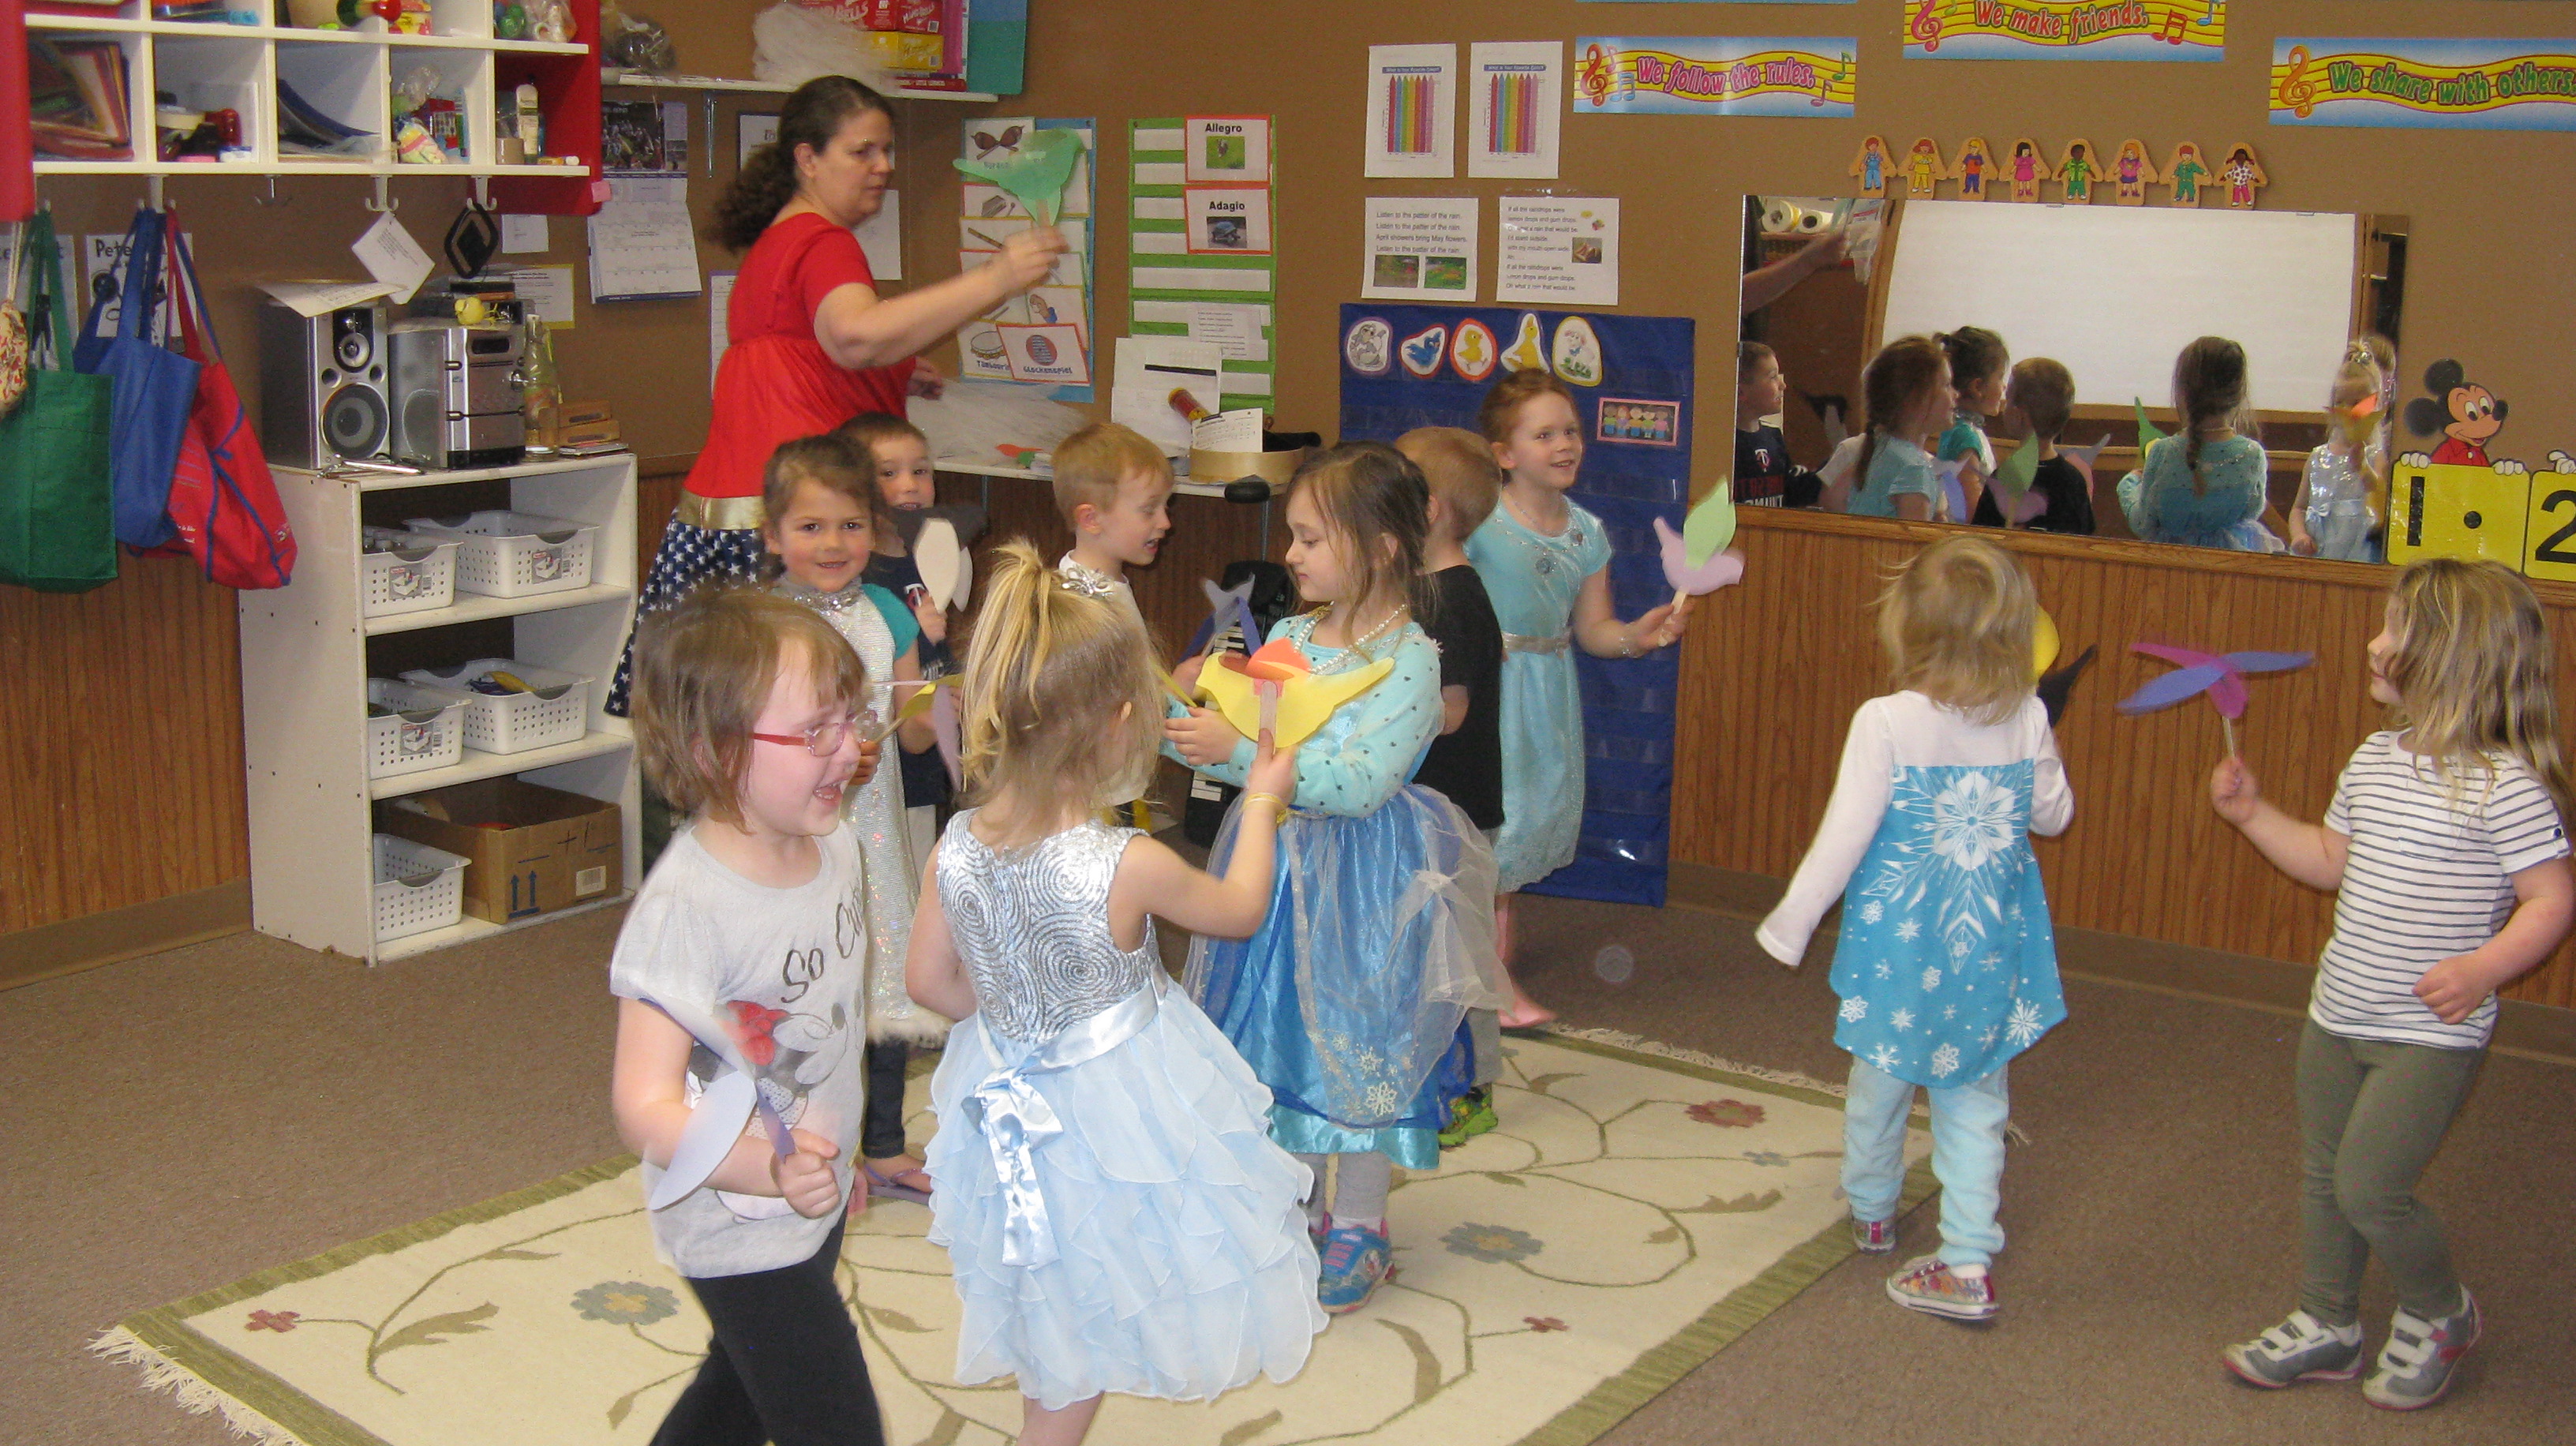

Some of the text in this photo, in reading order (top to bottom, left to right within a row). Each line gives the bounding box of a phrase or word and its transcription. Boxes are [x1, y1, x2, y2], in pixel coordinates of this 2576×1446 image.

[1975, 0, 2149, 44] We make friends.
[1638, 56, 1815, 95] We follow the rules.
[2328, 61, 2364, 92] We
[2368, 62, 2432, 103] share
[2437, 71, 2490, 105] with
[1205, 123, 1242, 134] Allegro
[1209, 200, 1245, 212] Adagio
[2535, 489, 2576, 564] 2
